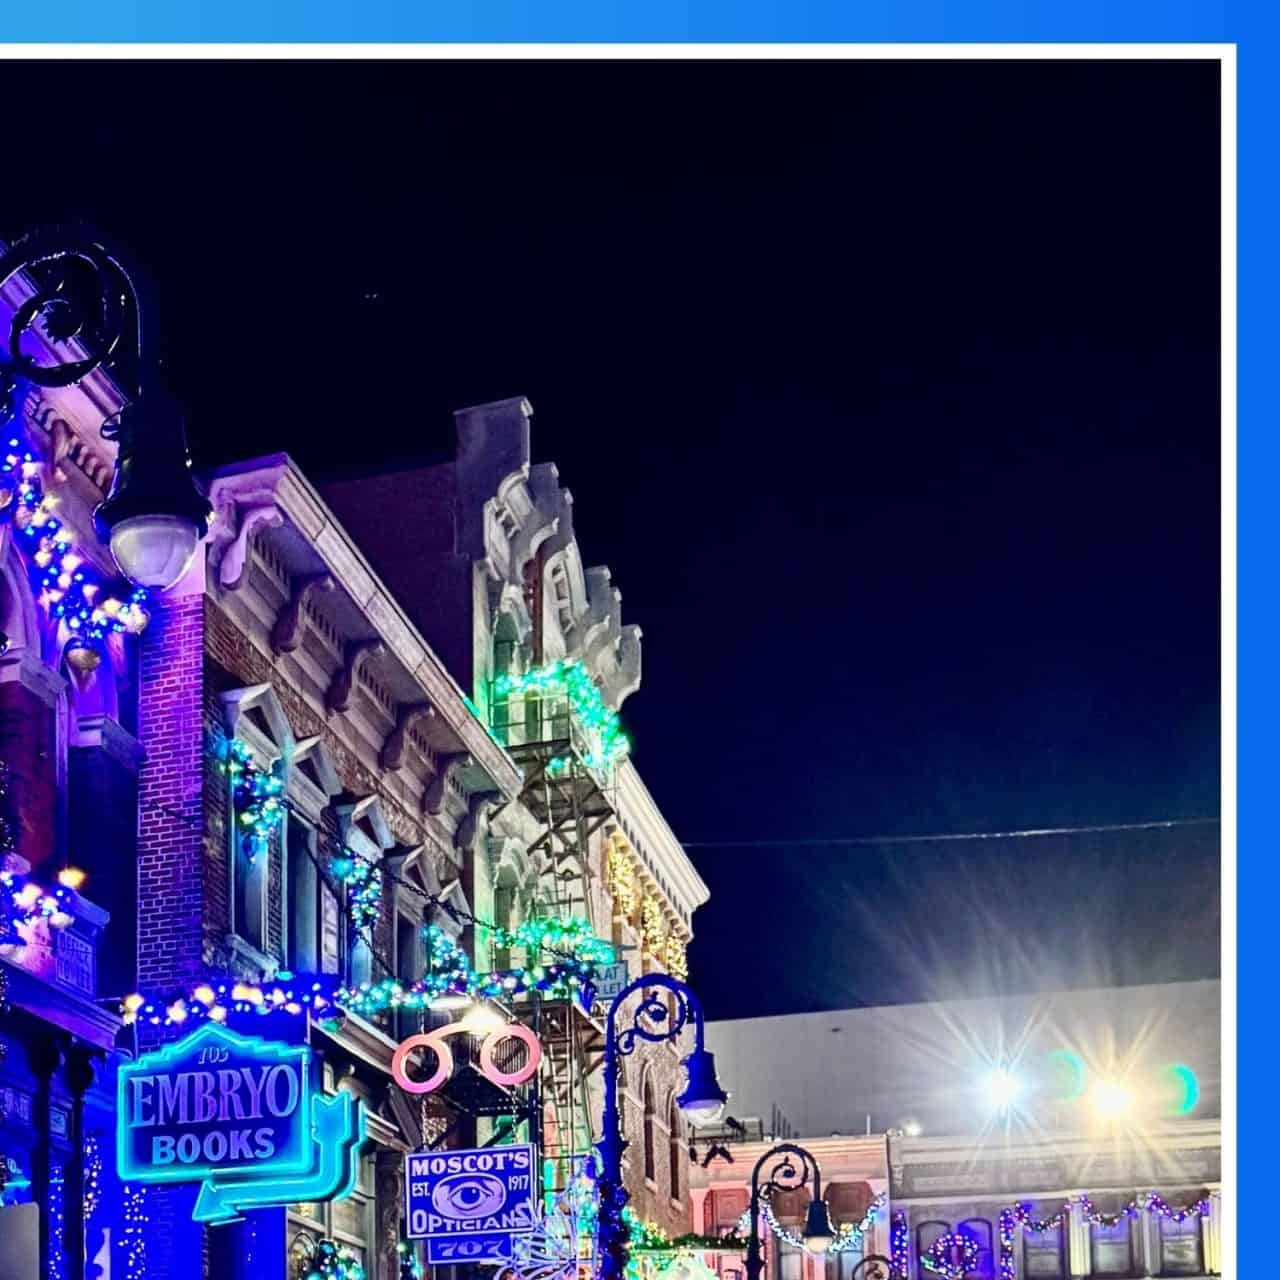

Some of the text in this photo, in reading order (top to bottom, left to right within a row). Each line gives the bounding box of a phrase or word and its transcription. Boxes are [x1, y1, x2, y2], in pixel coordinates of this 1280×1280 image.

[129, 1064, 299, 1128] EMBRYO
[152, 1128, 275, 1165] BOOKS
[411, 1151, 529, 1177] MOSCOT'S
[412, 1201, 531, 1233] OPTICIANS
[438, 1240, 504, 1257] 707
